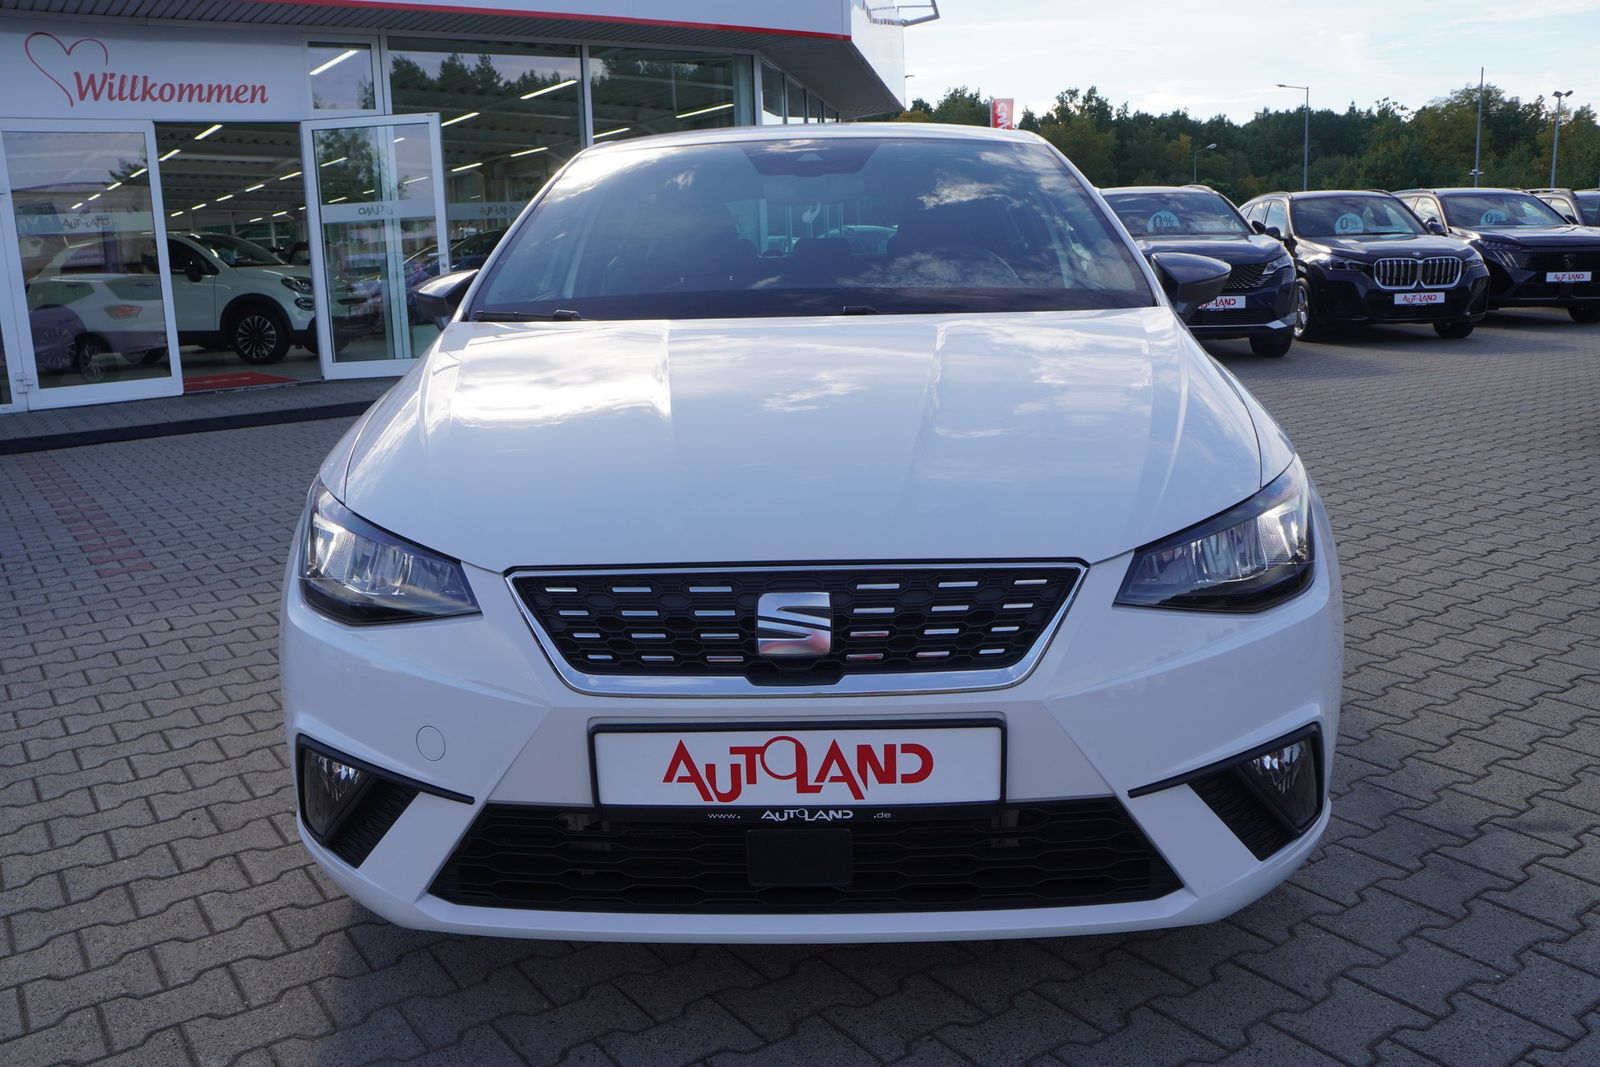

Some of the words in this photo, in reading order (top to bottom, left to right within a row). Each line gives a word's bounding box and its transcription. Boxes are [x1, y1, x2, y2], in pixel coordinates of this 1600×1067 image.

[74, 71, 269, 104] Willkommen
[1153, 214, 1174, 228] 0%
[1340, 216, 1359, 230] 0%
[662, 735, 934, 803] AUTOLAND
[707, 811, 741, 819] www.
[761, 808, 853, 822] AUTOLAND
[873, 811, 891, 819] .de
